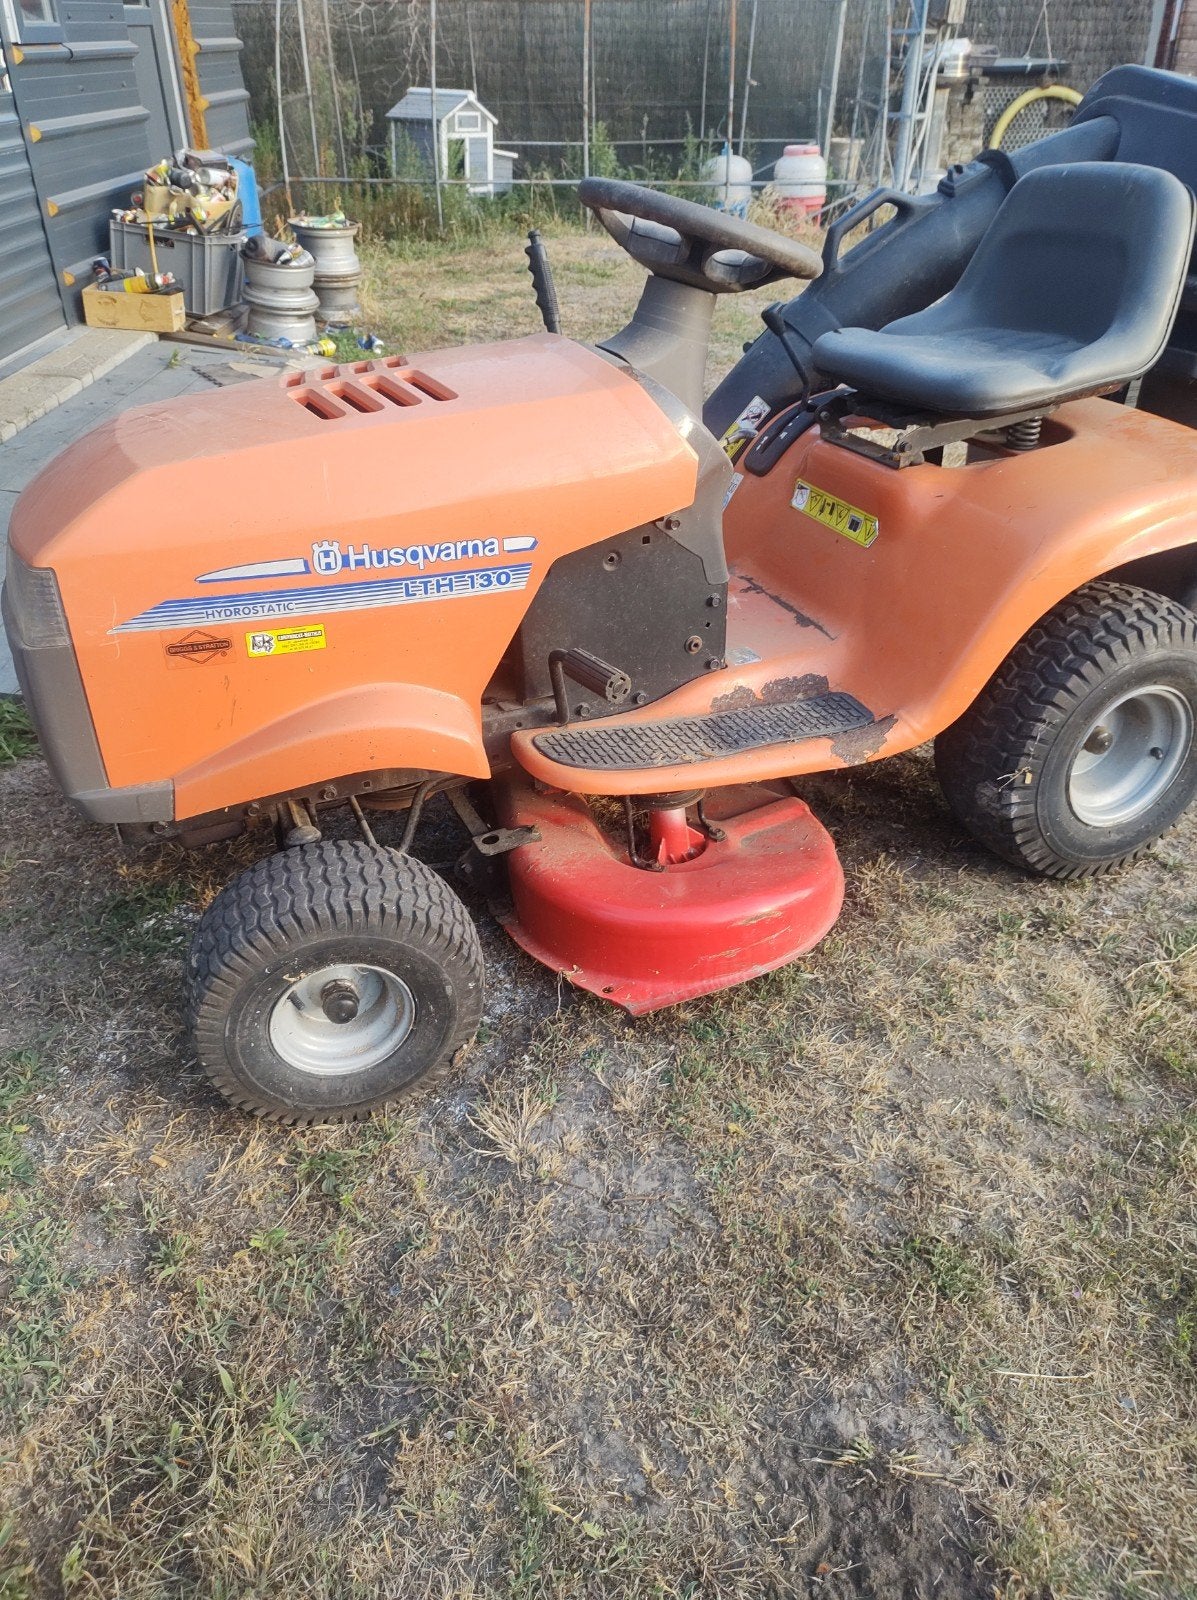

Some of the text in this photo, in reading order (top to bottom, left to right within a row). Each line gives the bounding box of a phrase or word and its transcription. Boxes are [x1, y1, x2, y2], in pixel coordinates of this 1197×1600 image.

[347, 537, 499, 571] Husqvarna
[404, 570, 511, 597] LTH 130
[205, 602, 295, 619] HYDROSTATIC
[169, 645, 193, 654] BRIGGS
[198, 641, 229, 651] STRATTON
